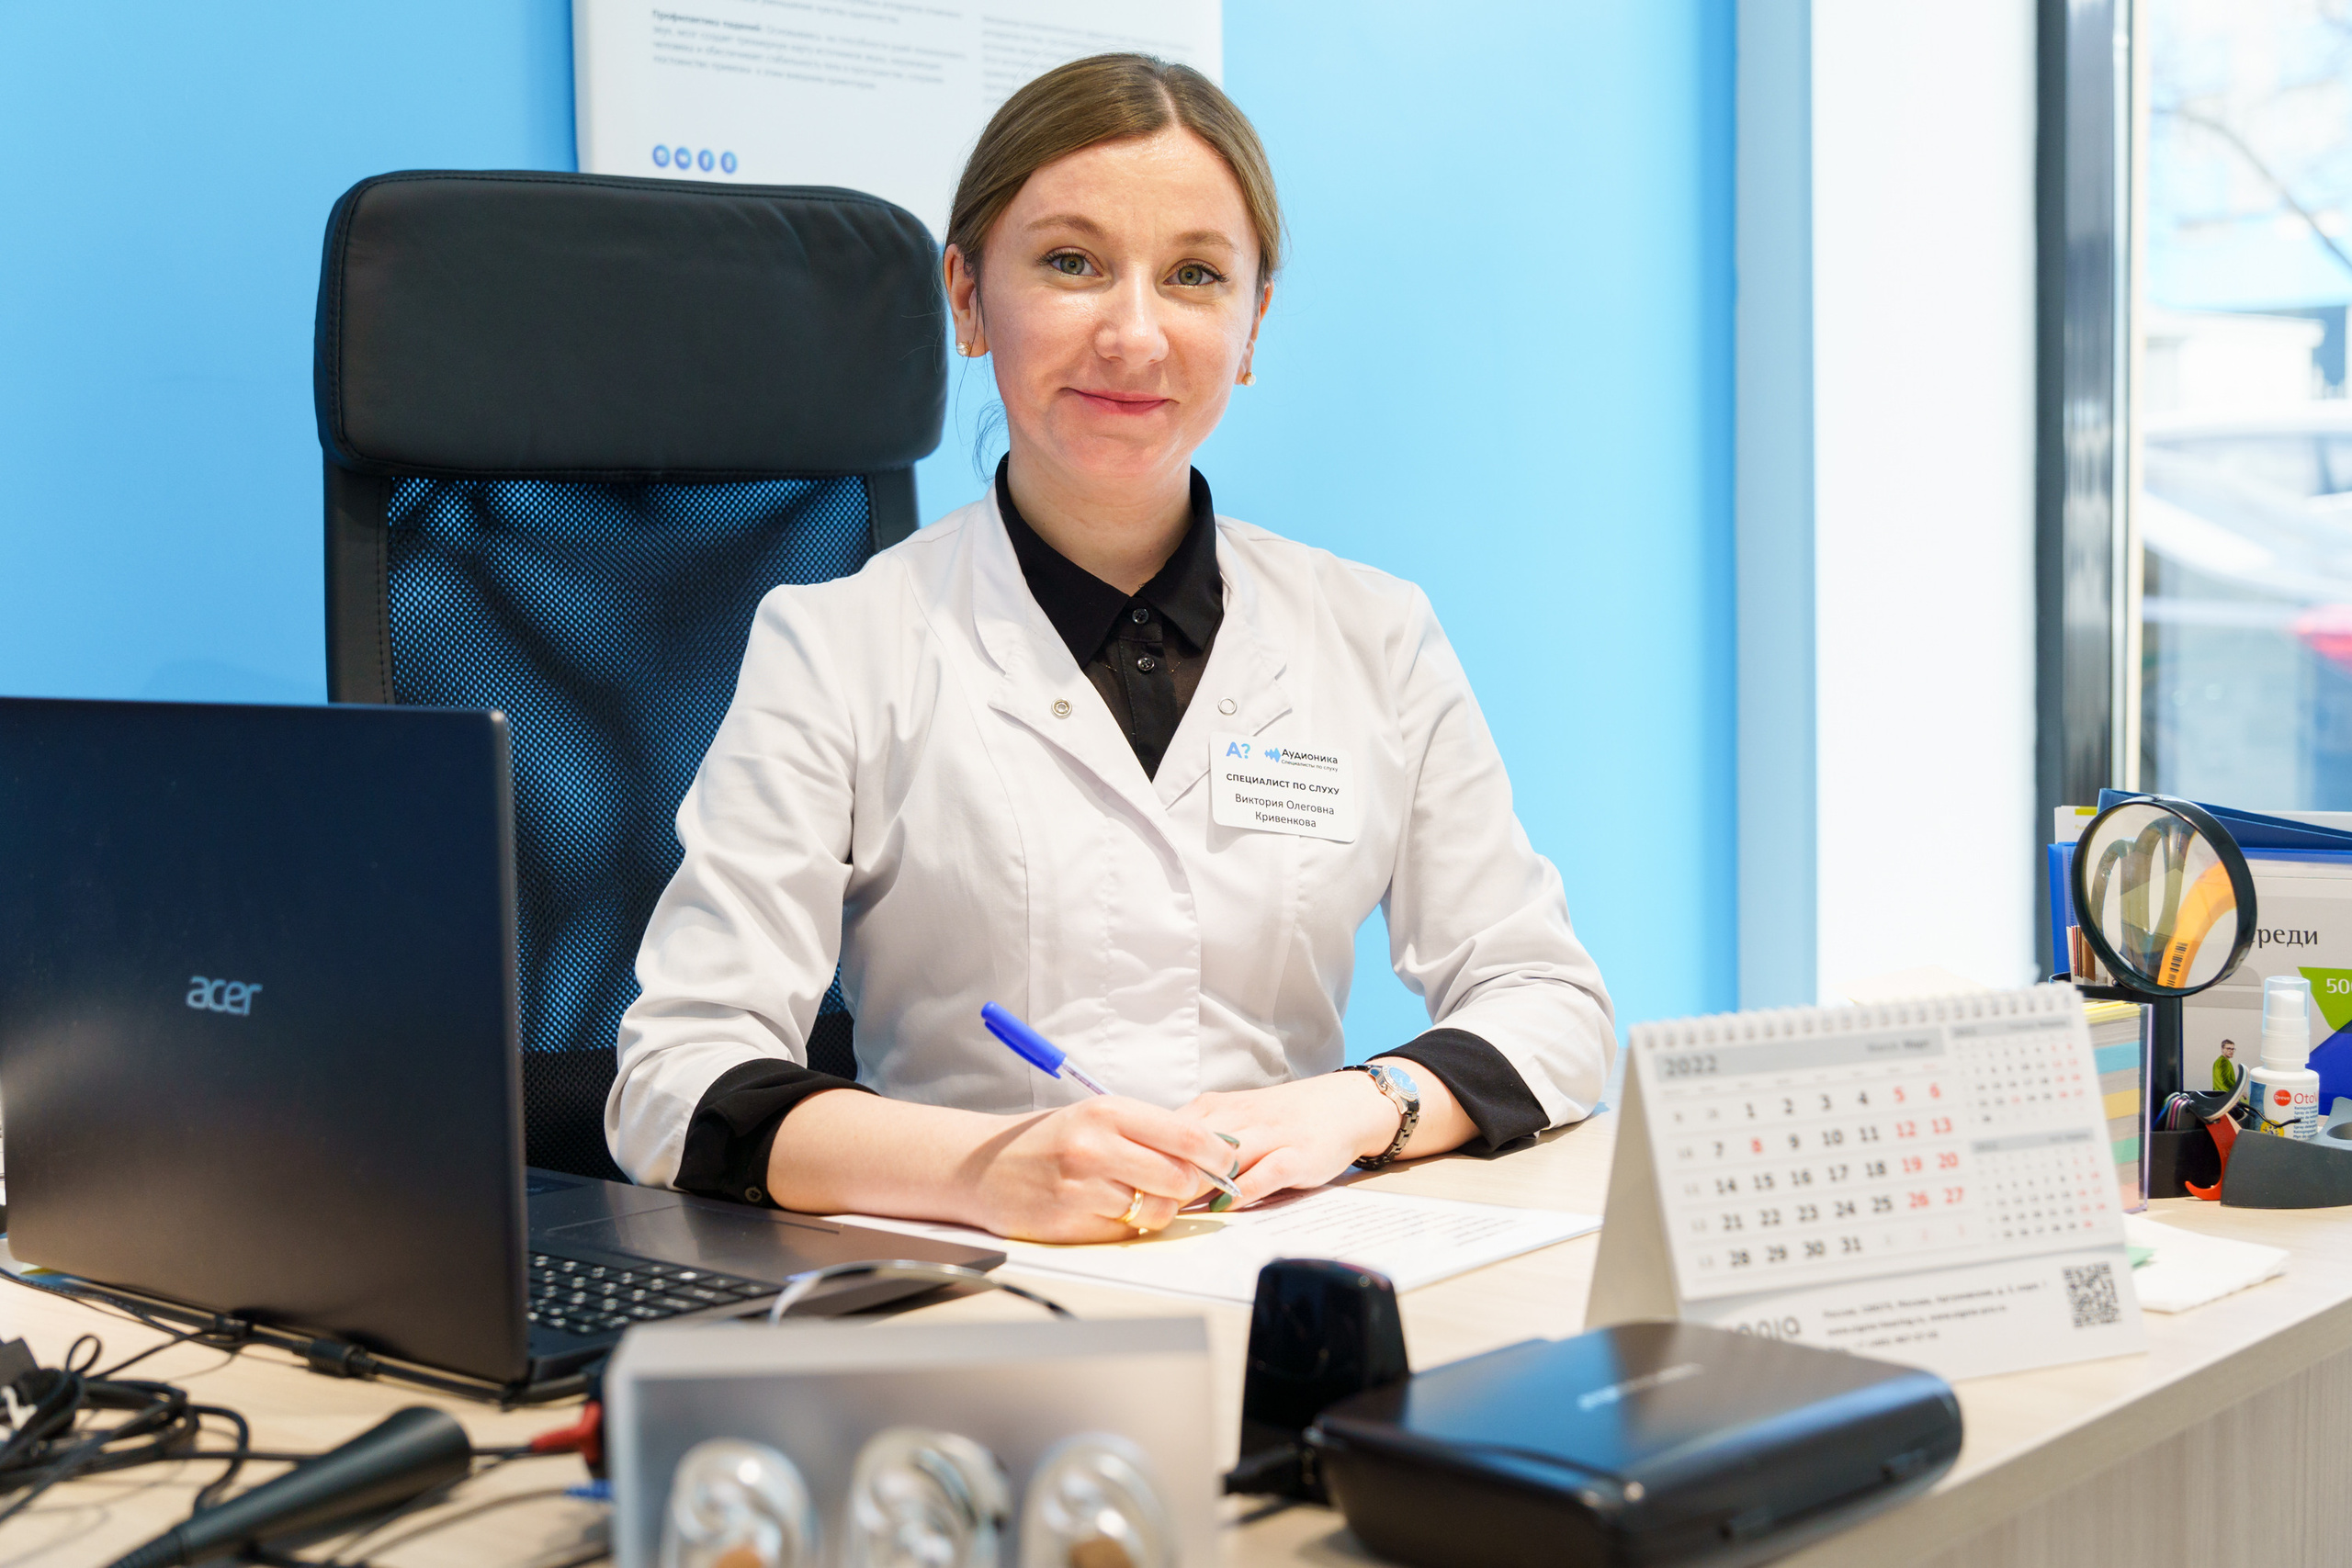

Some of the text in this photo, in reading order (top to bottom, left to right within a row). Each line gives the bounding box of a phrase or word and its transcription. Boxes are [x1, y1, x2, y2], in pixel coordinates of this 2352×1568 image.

[1281, 749, 1339, 764] Аудионика
[1281, 759, 1315, 769] Специалисты
[1226, 773, 1340, 795] СПЕЦИАЛИСТ ПО СЛУХУ
[1235, 793, 1335, 815] Виктория Олеговна
[1255, 812, 1317, 828] Кривенкова
[2253, 928, 2318, 949] реди
[186, 975, 263, 1017] acer
[1665, 1055, 1718, 1077] 2022
[1746, 1083, 1941, 1119] 1 2 3 4 5 6
[1714, 1141, 1724, 1156] 7
[1750, 1137, 1764, 1155] 8
[1788, 1133, 1801, 1150] 9
[1822, 1129, 1844, 1146] 10
[1859, 1125, 1880, 1143] 11
[1896, 1121, 1917, 1138] 12
[1931, 1117, 1952, 1134] 13
[1715, 1178, 1738, 1195] 14
[1753, 1172, 1775, 1190] 15
[1791, 1168, 1813, 1187] 16
[1828, 1164, 1849, 1182] 17
[1865, 1160, 1887, 1179] 18
[1902, 1156, 1923, 1174] 19
[1939, 1152, 1959, 1169] 20
[1723, 1213, 1744, 1232] 21
[1759, 1208, 1781, 1227] 22
[1798, 1204, 1819, 1223] 23
[1835, 1201, 1857, 1218] 24
[1871, 1195, 1894, 1213] 25
[1908, 1191, 1930, 1209] 26
[1945, 1186, 1963, 1204] 27
[1730, 1248, 1752, 1268] 28
[1767, 1245, 1789, 1263] 29
[1804, 1240, 1826, 1258] 30
[1841, 1236, 1862, 1254] 31
